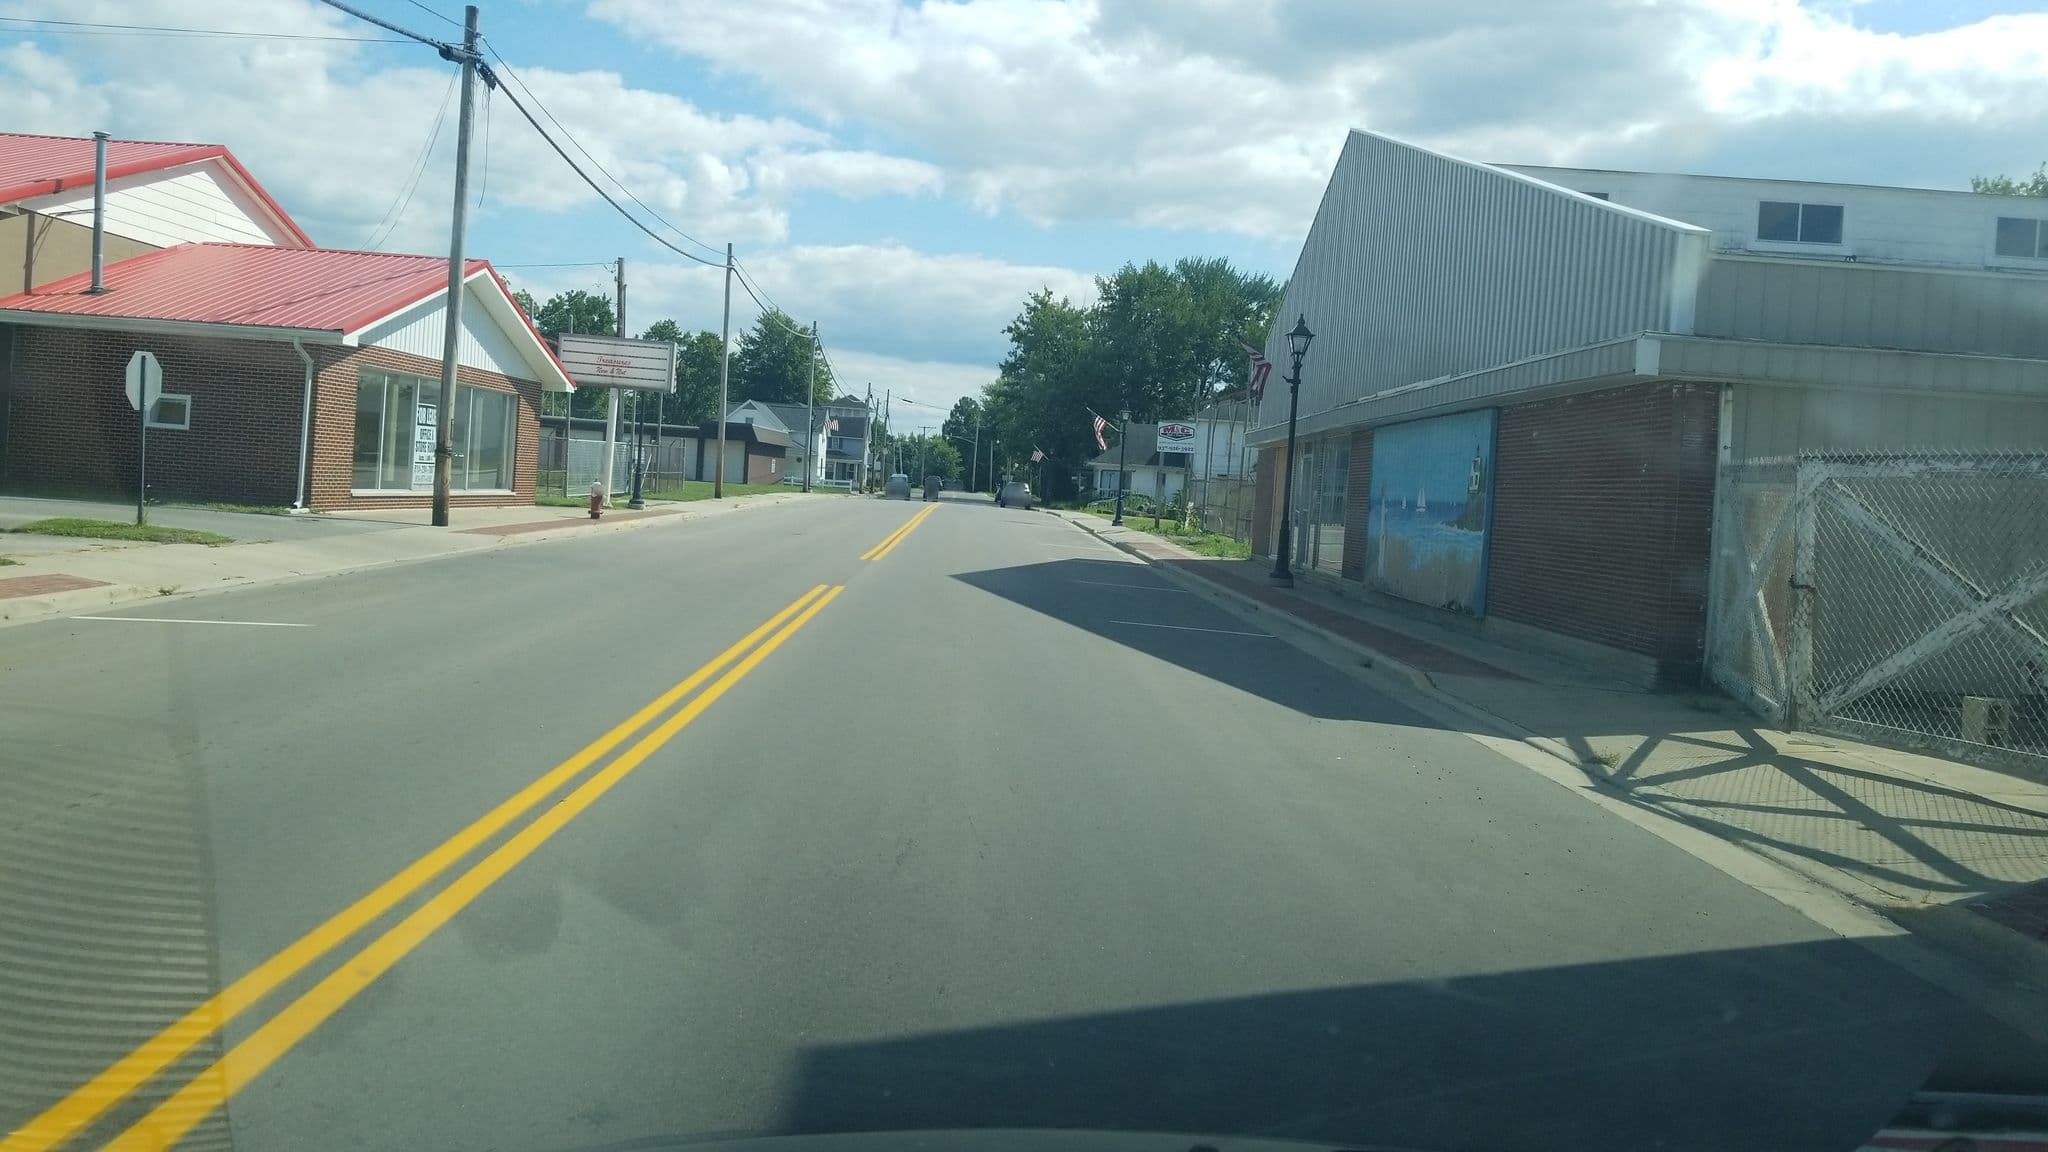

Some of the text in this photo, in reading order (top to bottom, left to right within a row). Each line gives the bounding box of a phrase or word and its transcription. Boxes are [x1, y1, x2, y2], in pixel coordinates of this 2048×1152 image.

[596, 355, 632, 365] Treasures
[416, 406, 427, 425] FOR
[416, 441, 427, 452] STORE
